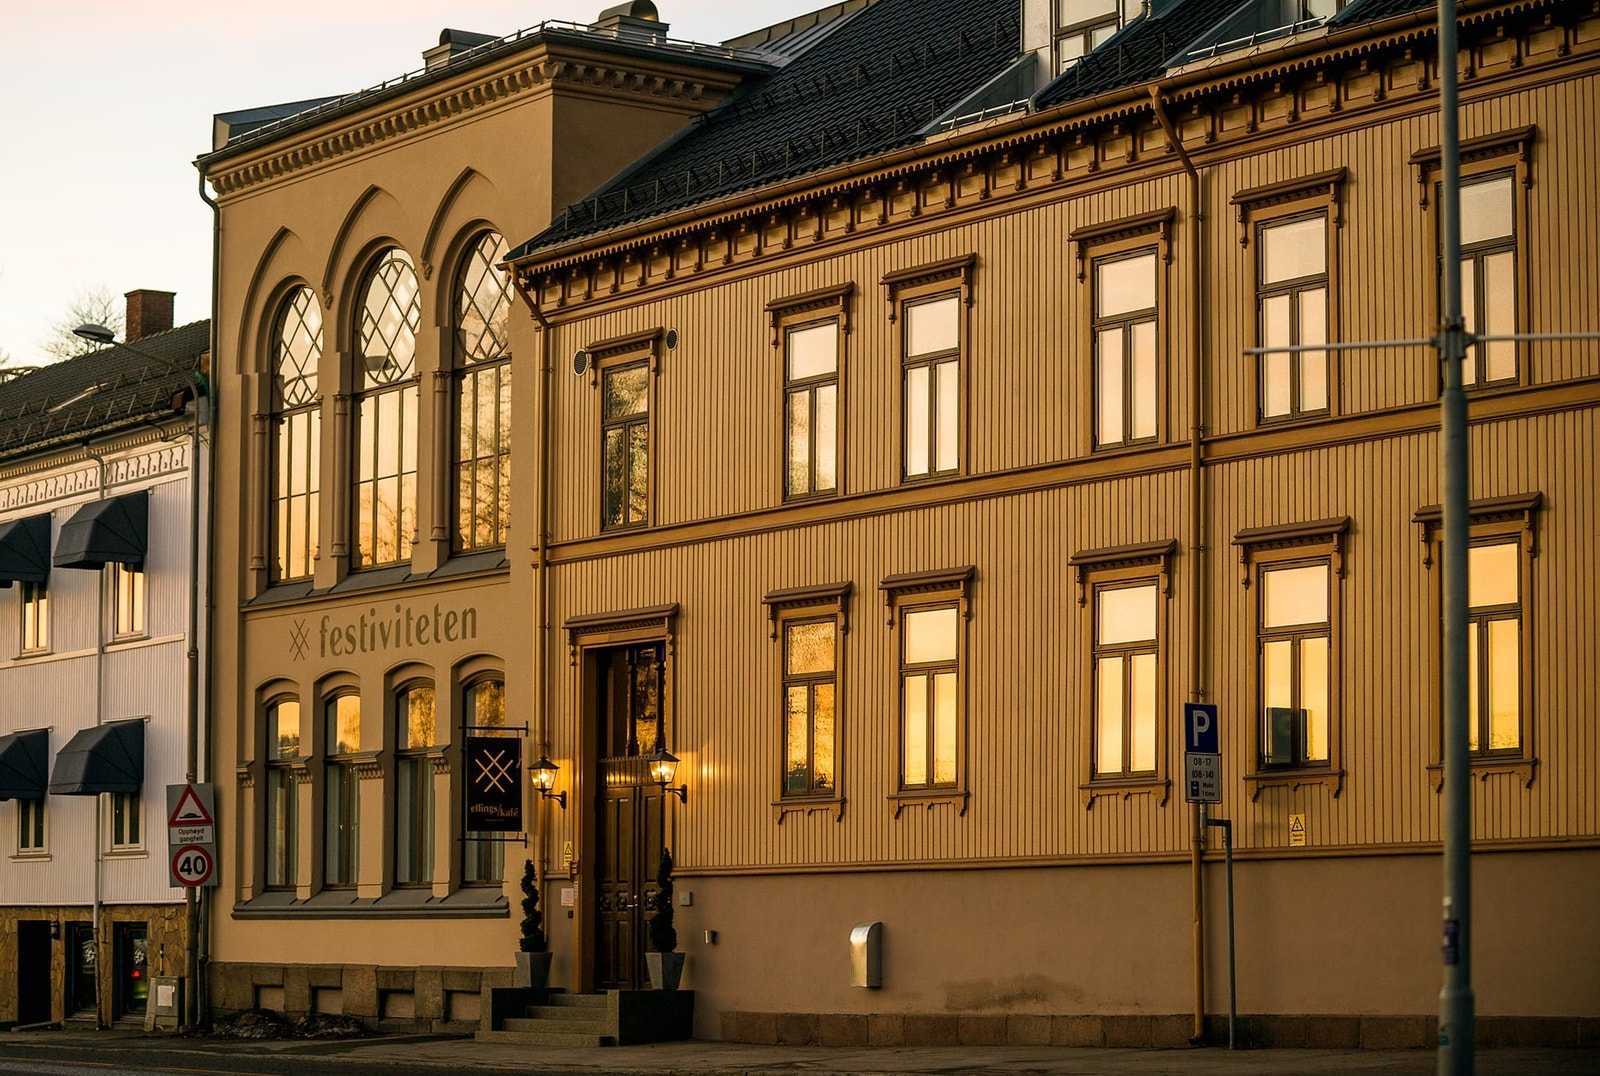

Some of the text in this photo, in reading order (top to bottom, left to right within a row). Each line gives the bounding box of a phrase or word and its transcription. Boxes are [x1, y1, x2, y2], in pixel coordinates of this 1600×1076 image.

[319, 602, 477, 658] festiviteten
[1192, 709, 1210, 747] P
[179, 855, 207, 876] 40
